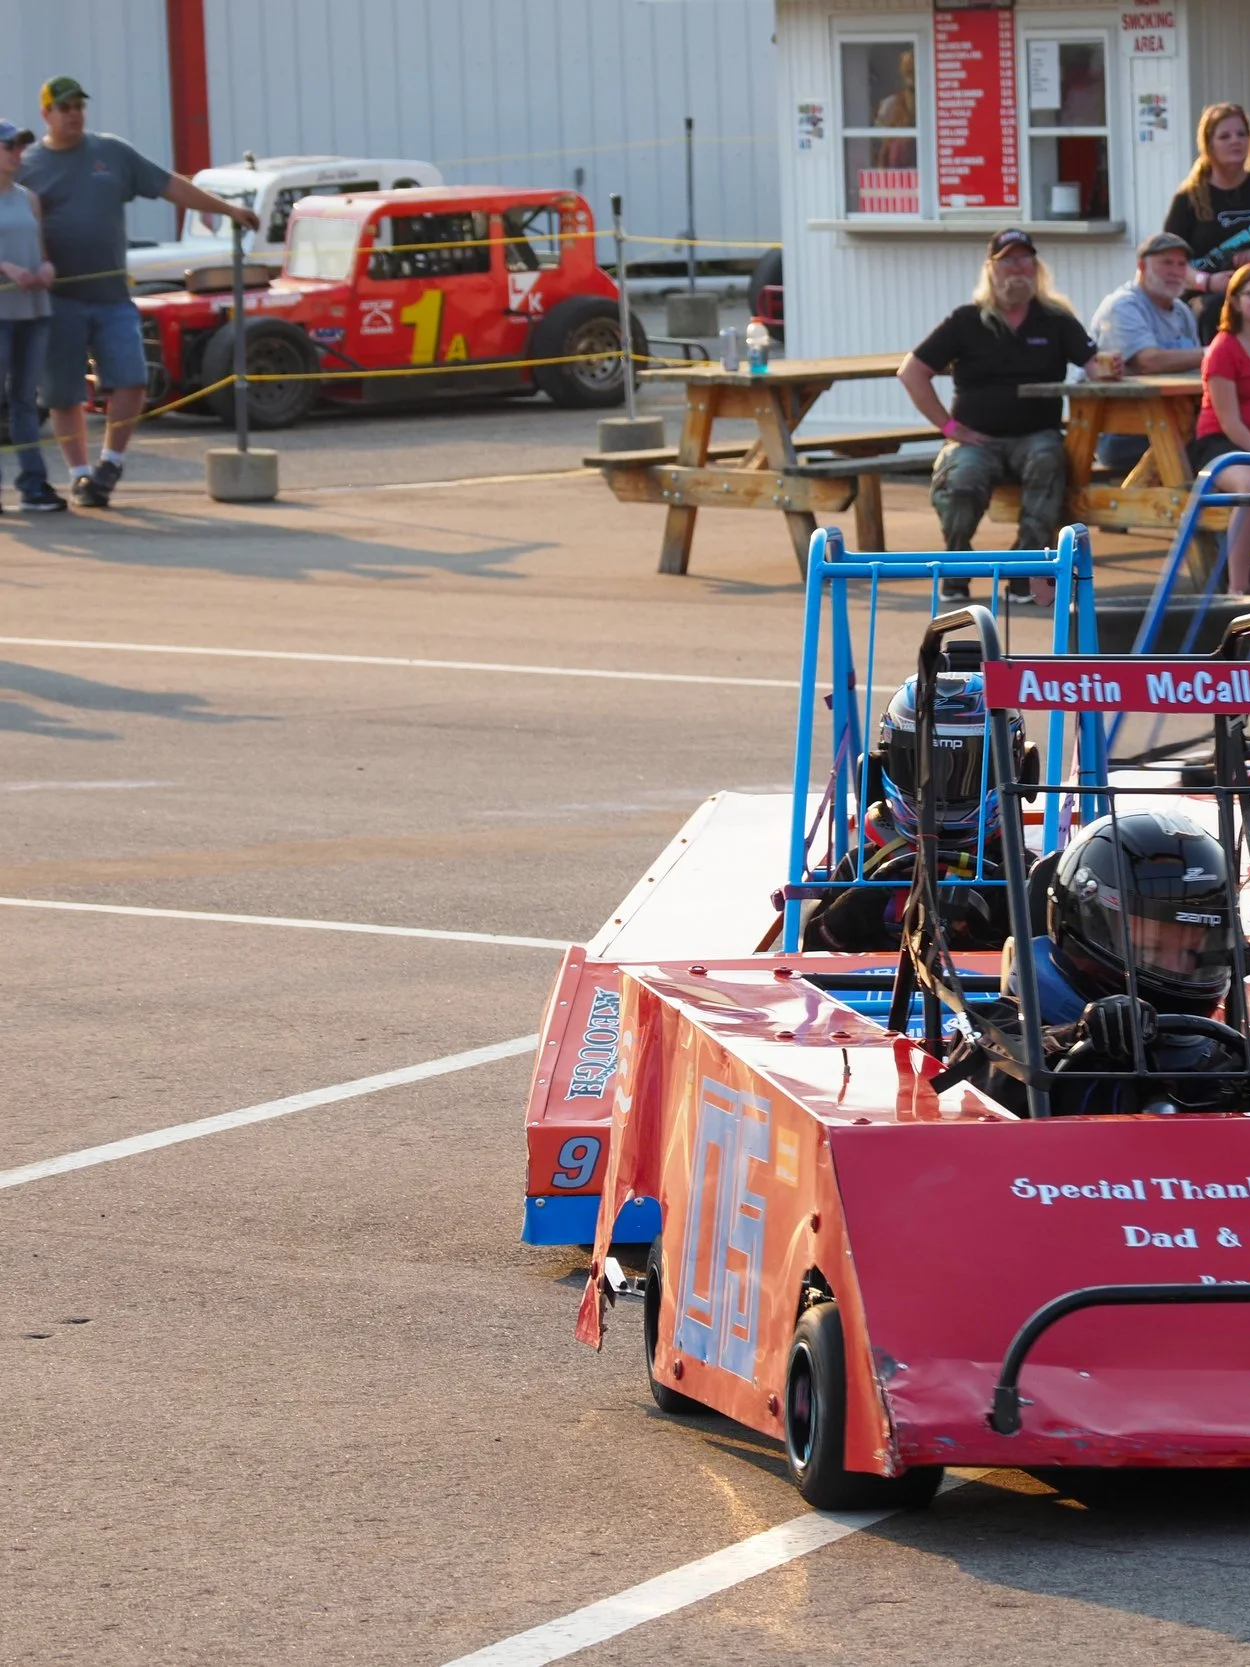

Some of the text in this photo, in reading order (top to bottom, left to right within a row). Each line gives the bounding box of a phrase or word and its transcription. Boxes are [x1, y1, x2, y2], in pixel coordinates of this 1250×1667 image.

[1121, 12, 1176, 31] SMOKING
[1134, 35, 1164, 52] AREA
[1018, 669, 1121, 703] Austin
[933, 738, 963, 750] amp
[1175, 911, 1222, 927] zamp
[564, 986, 620, 1101] KEOUGH
[551, 1135, 602, 1190] 9
[1010, 1177, 1148, 1205] Special
[1122, 1225, 1199, 1249] Dad
[1216, 1226, 1242, 1247] &
